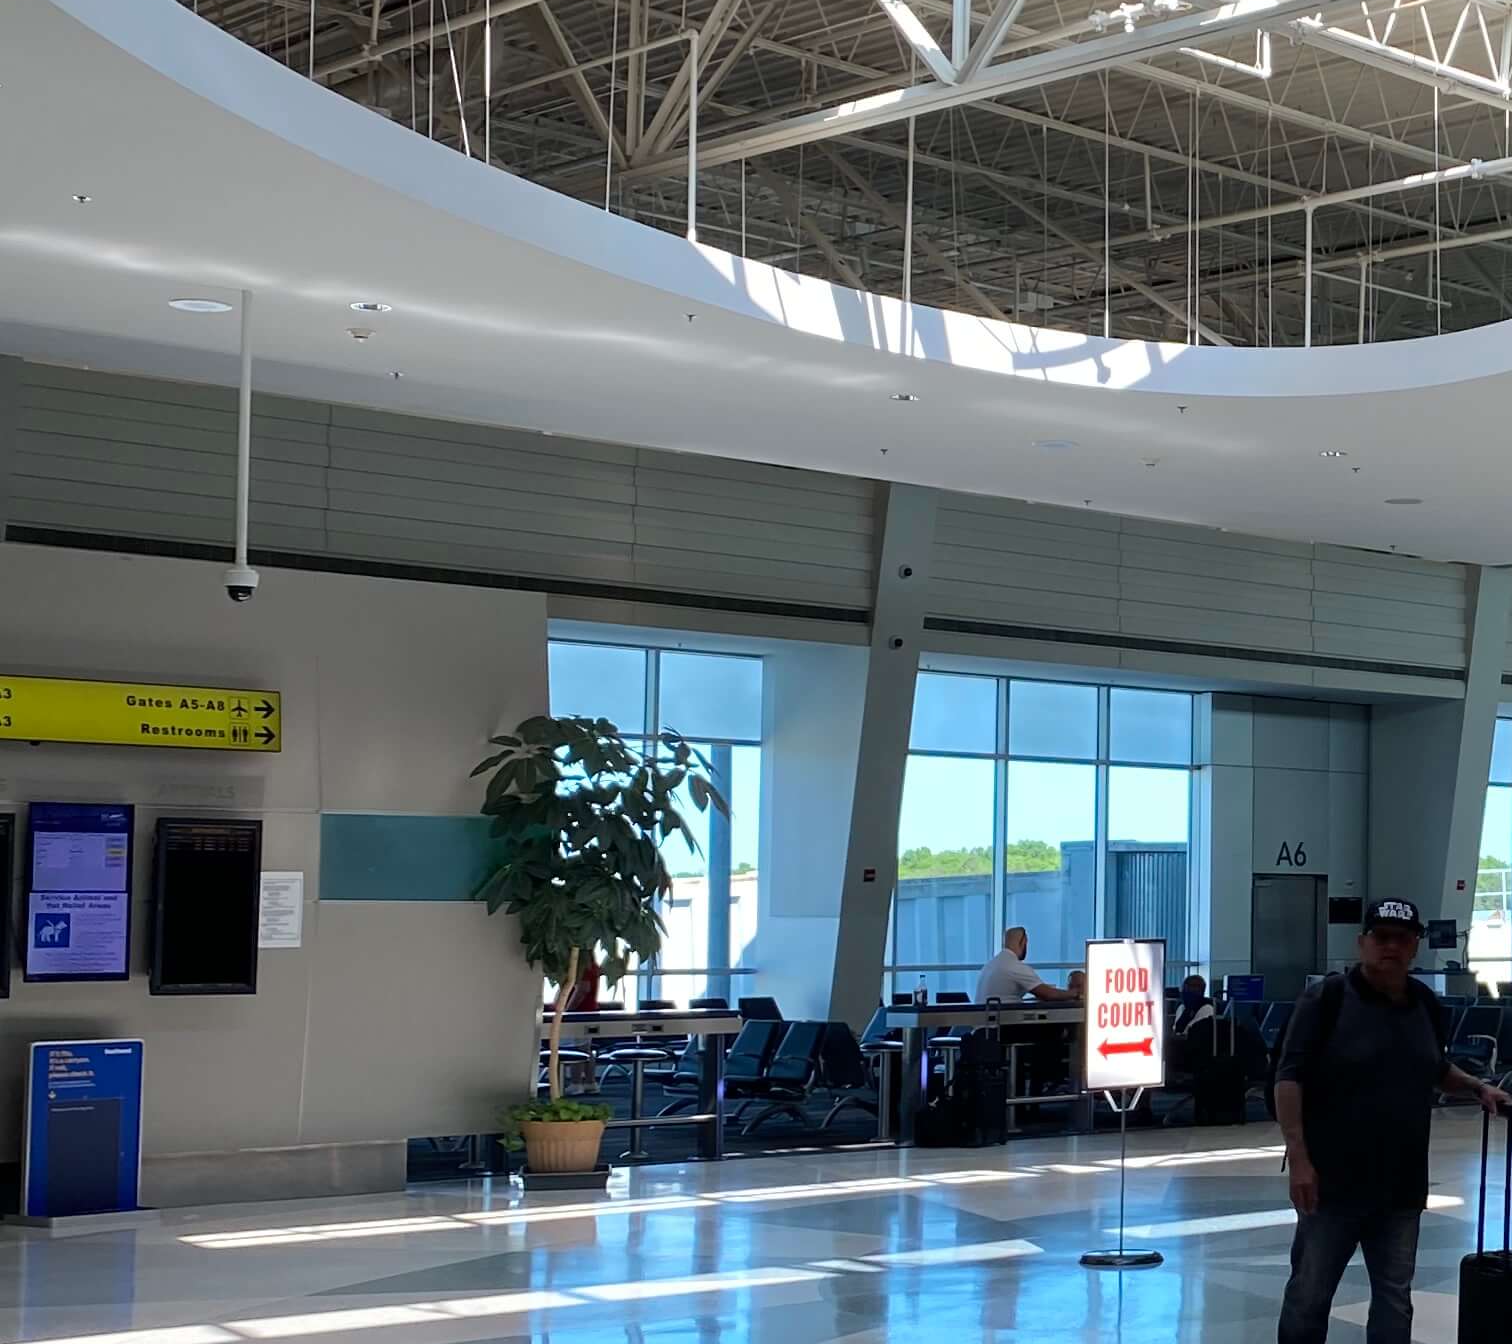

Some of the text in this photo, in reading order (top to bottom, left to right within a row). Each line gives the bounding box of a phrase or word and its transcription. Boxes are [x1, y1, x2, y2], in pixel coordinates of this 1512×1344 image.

[0, 687, 12, 699] 3
[126, 695, 225, 712] Gates A5-A8
[0, 715, 12, 727] 3
[141, 723, 226, 739] Restrooms
[1275, 840, 1307, 867] A6
[1378, 906, 1414, 921] WARS
[1383, 901, 1412, 912] STAR
[1105, 967, 1149, 994] FOOD
[1097, 1001, 1155, 1028] COURT
